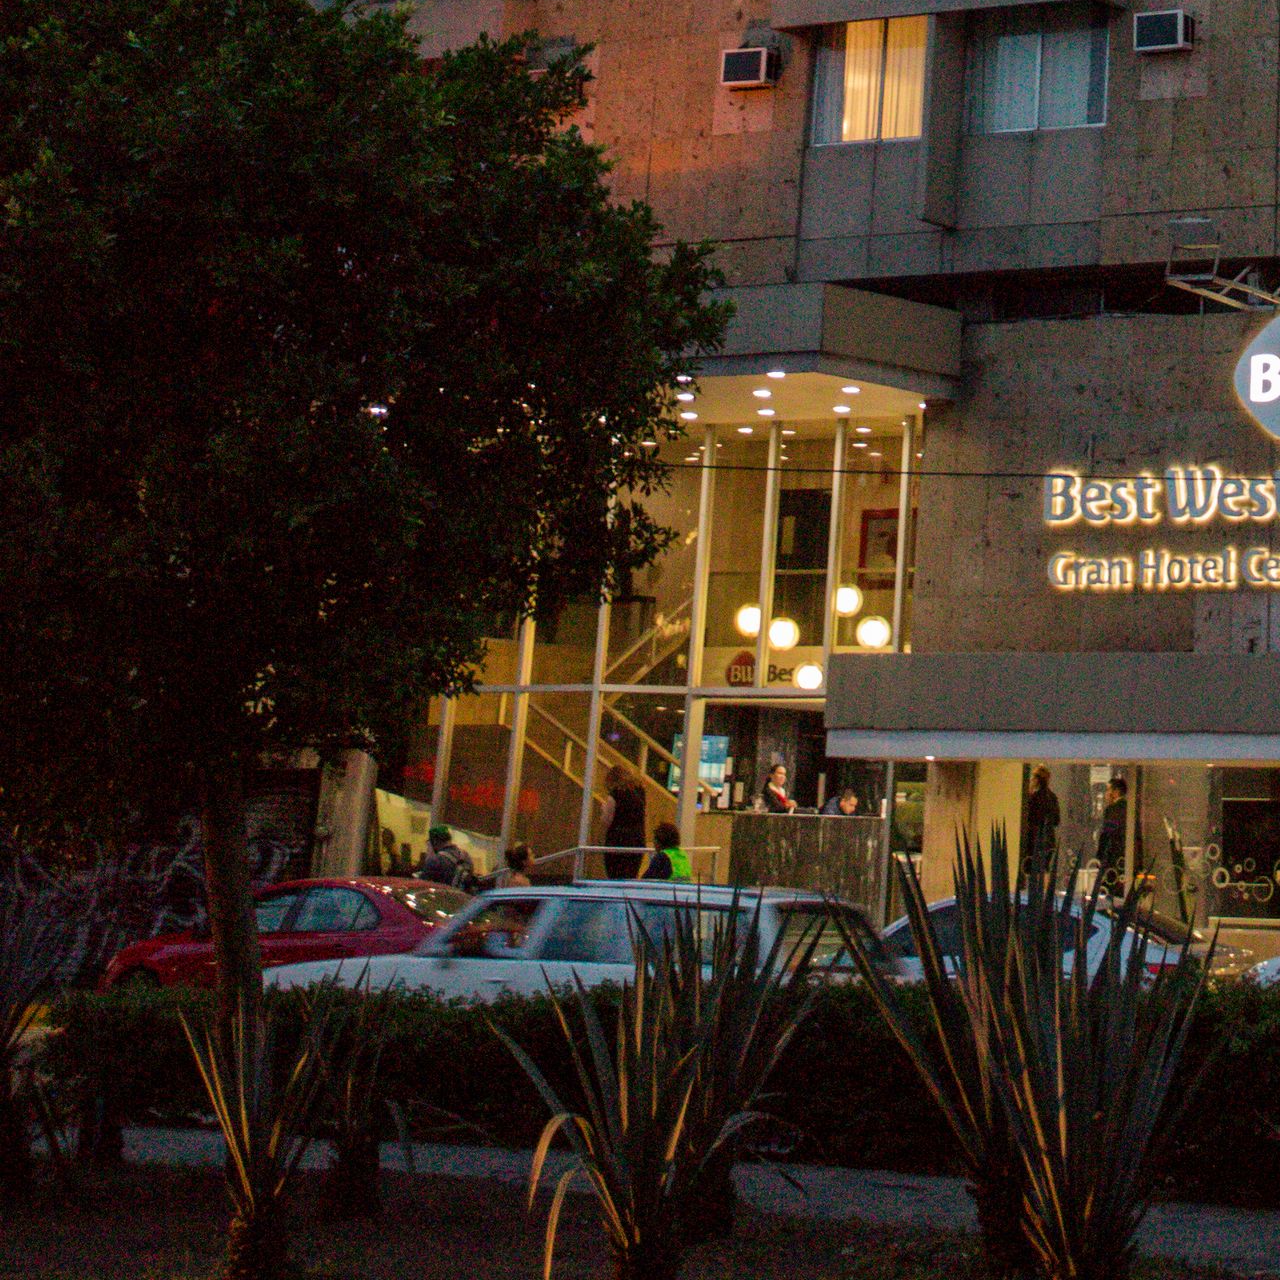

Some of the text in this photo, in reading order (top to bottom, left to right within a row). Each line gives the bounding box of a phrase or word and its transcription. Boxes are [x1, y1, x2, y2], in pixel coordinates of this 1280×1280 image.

[1044, 470, 1161, 524] Best
[1048, 551, 1133, 588] Gran
[1139, 546, 1236, 588] Hotel
